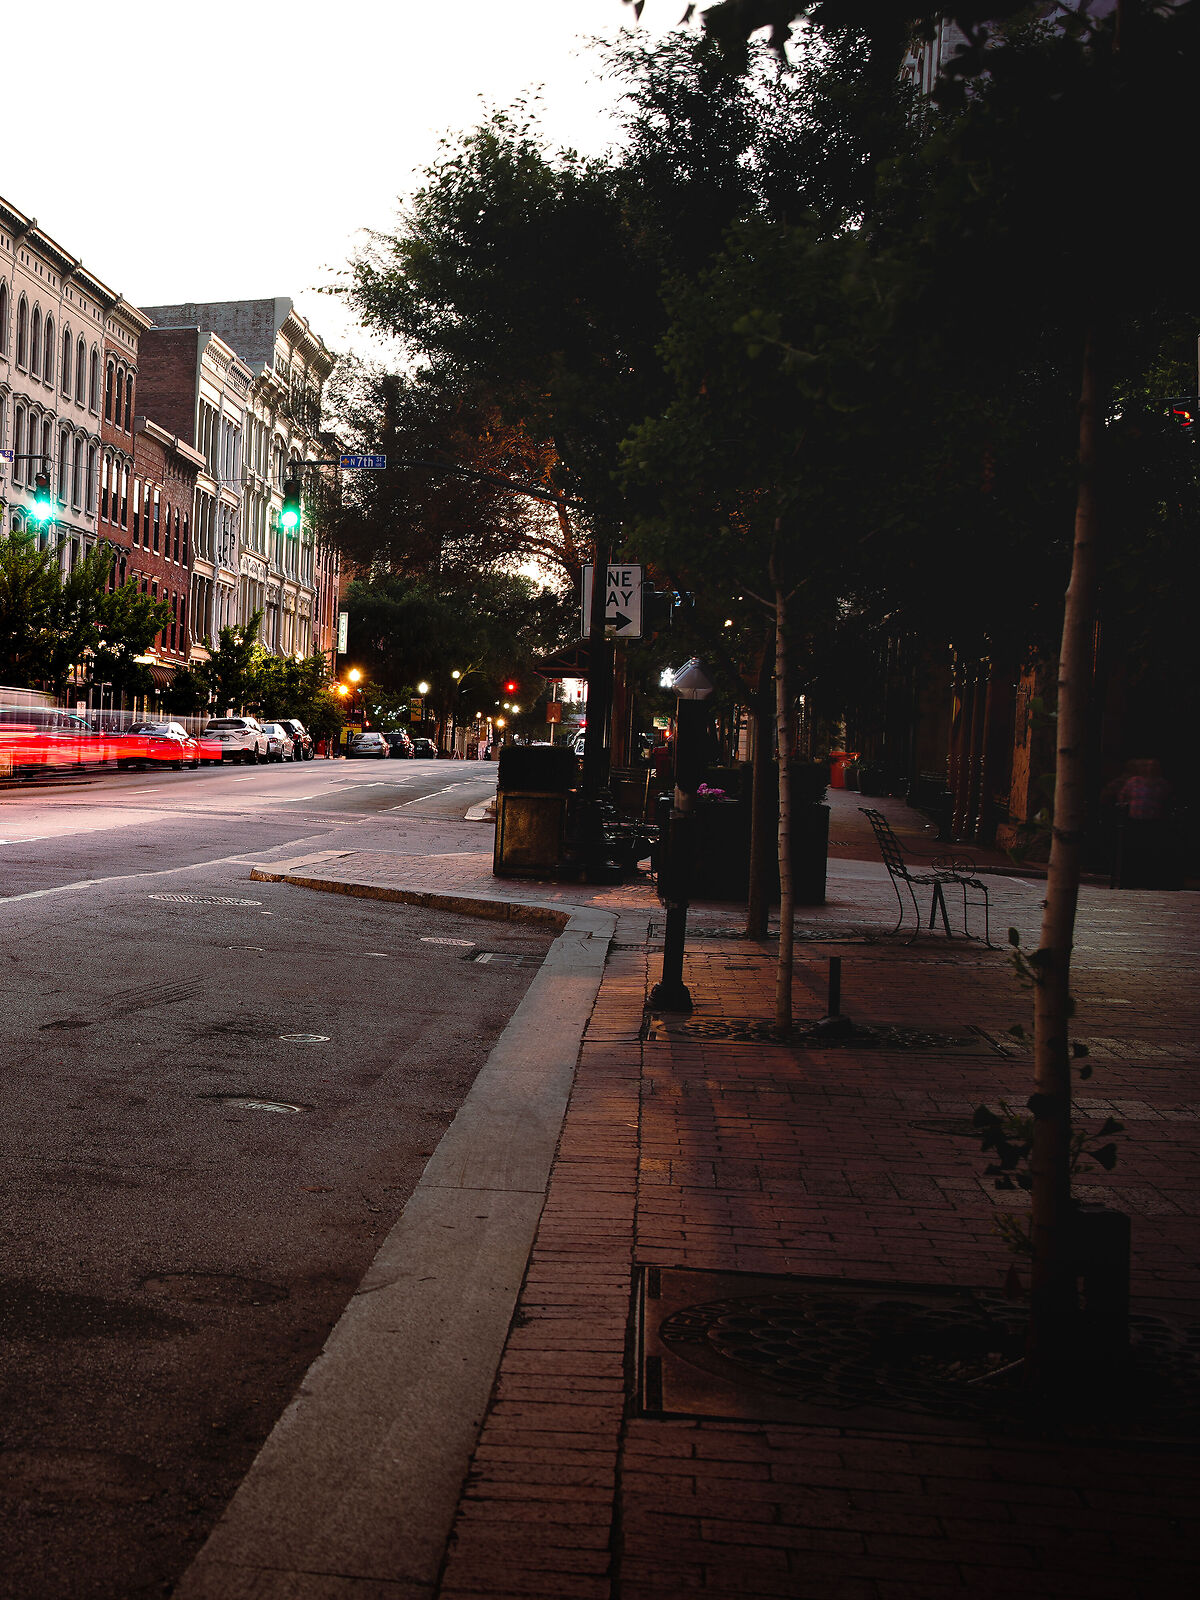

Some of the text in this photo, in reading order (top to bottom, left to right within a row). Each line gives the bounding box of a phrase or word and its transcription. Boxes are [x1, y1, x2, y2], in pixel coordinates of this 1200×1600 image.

[357, 457, 373, 467] 7th
[607, 571, 632, 587] NE
[606, 591, 633, 606] AY
